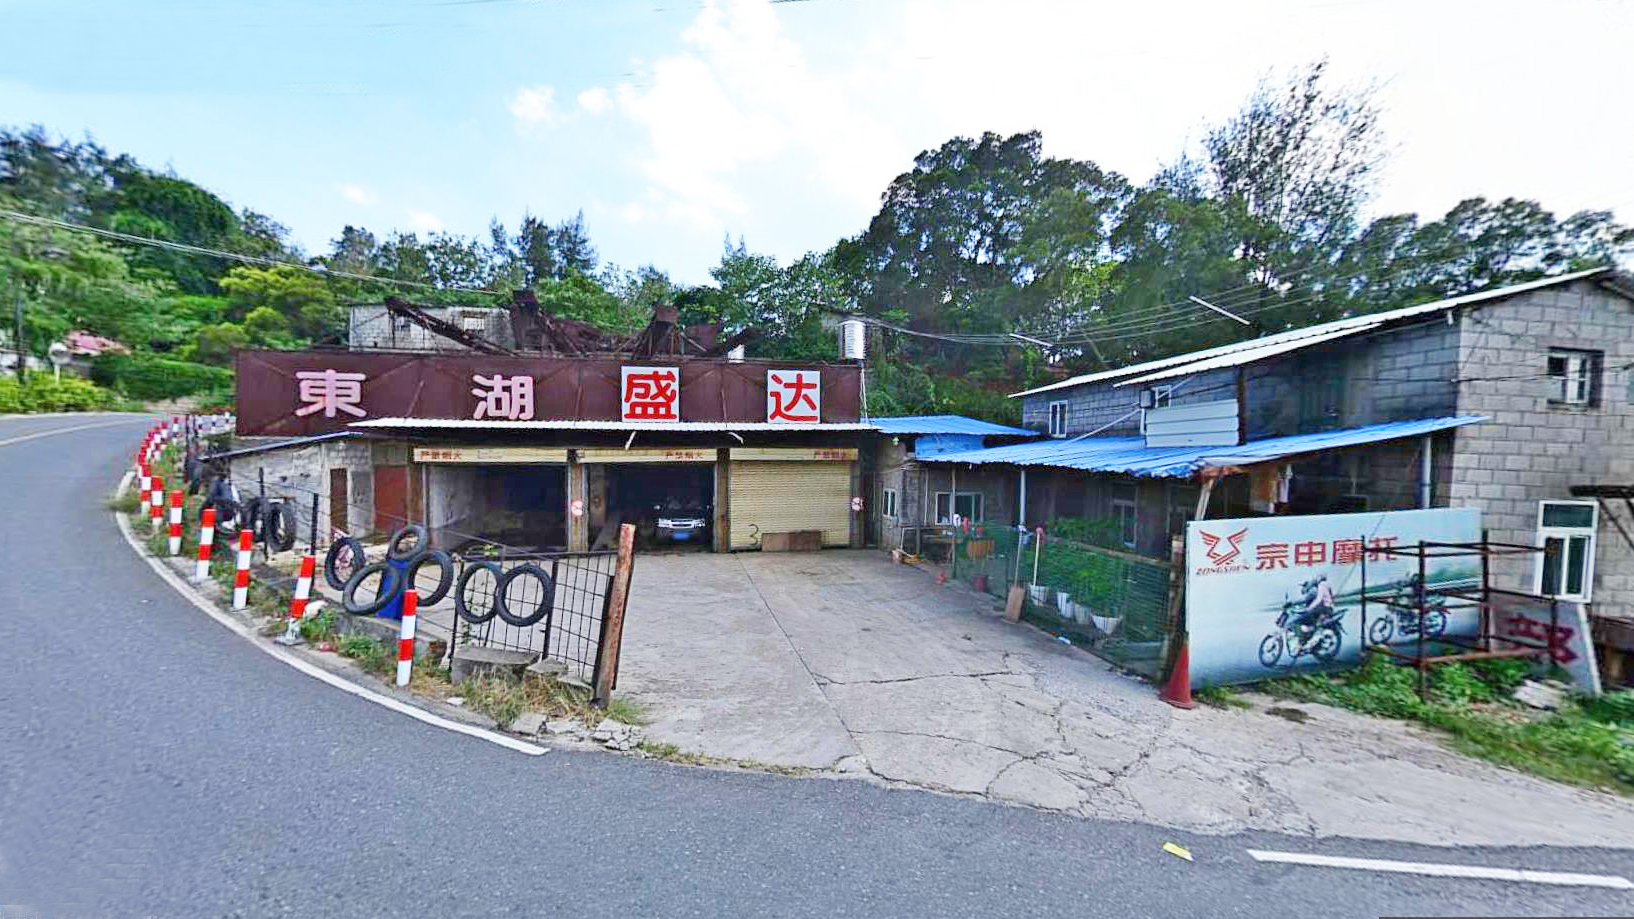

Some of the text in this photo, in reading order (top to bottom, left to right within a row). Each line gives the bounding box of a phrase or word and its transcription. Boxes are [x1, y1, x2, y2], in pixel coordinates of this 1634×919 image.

[295, 369, 820, 422] 東湖盛达
[1256, 537, 1398, 570] 宗申摩托
